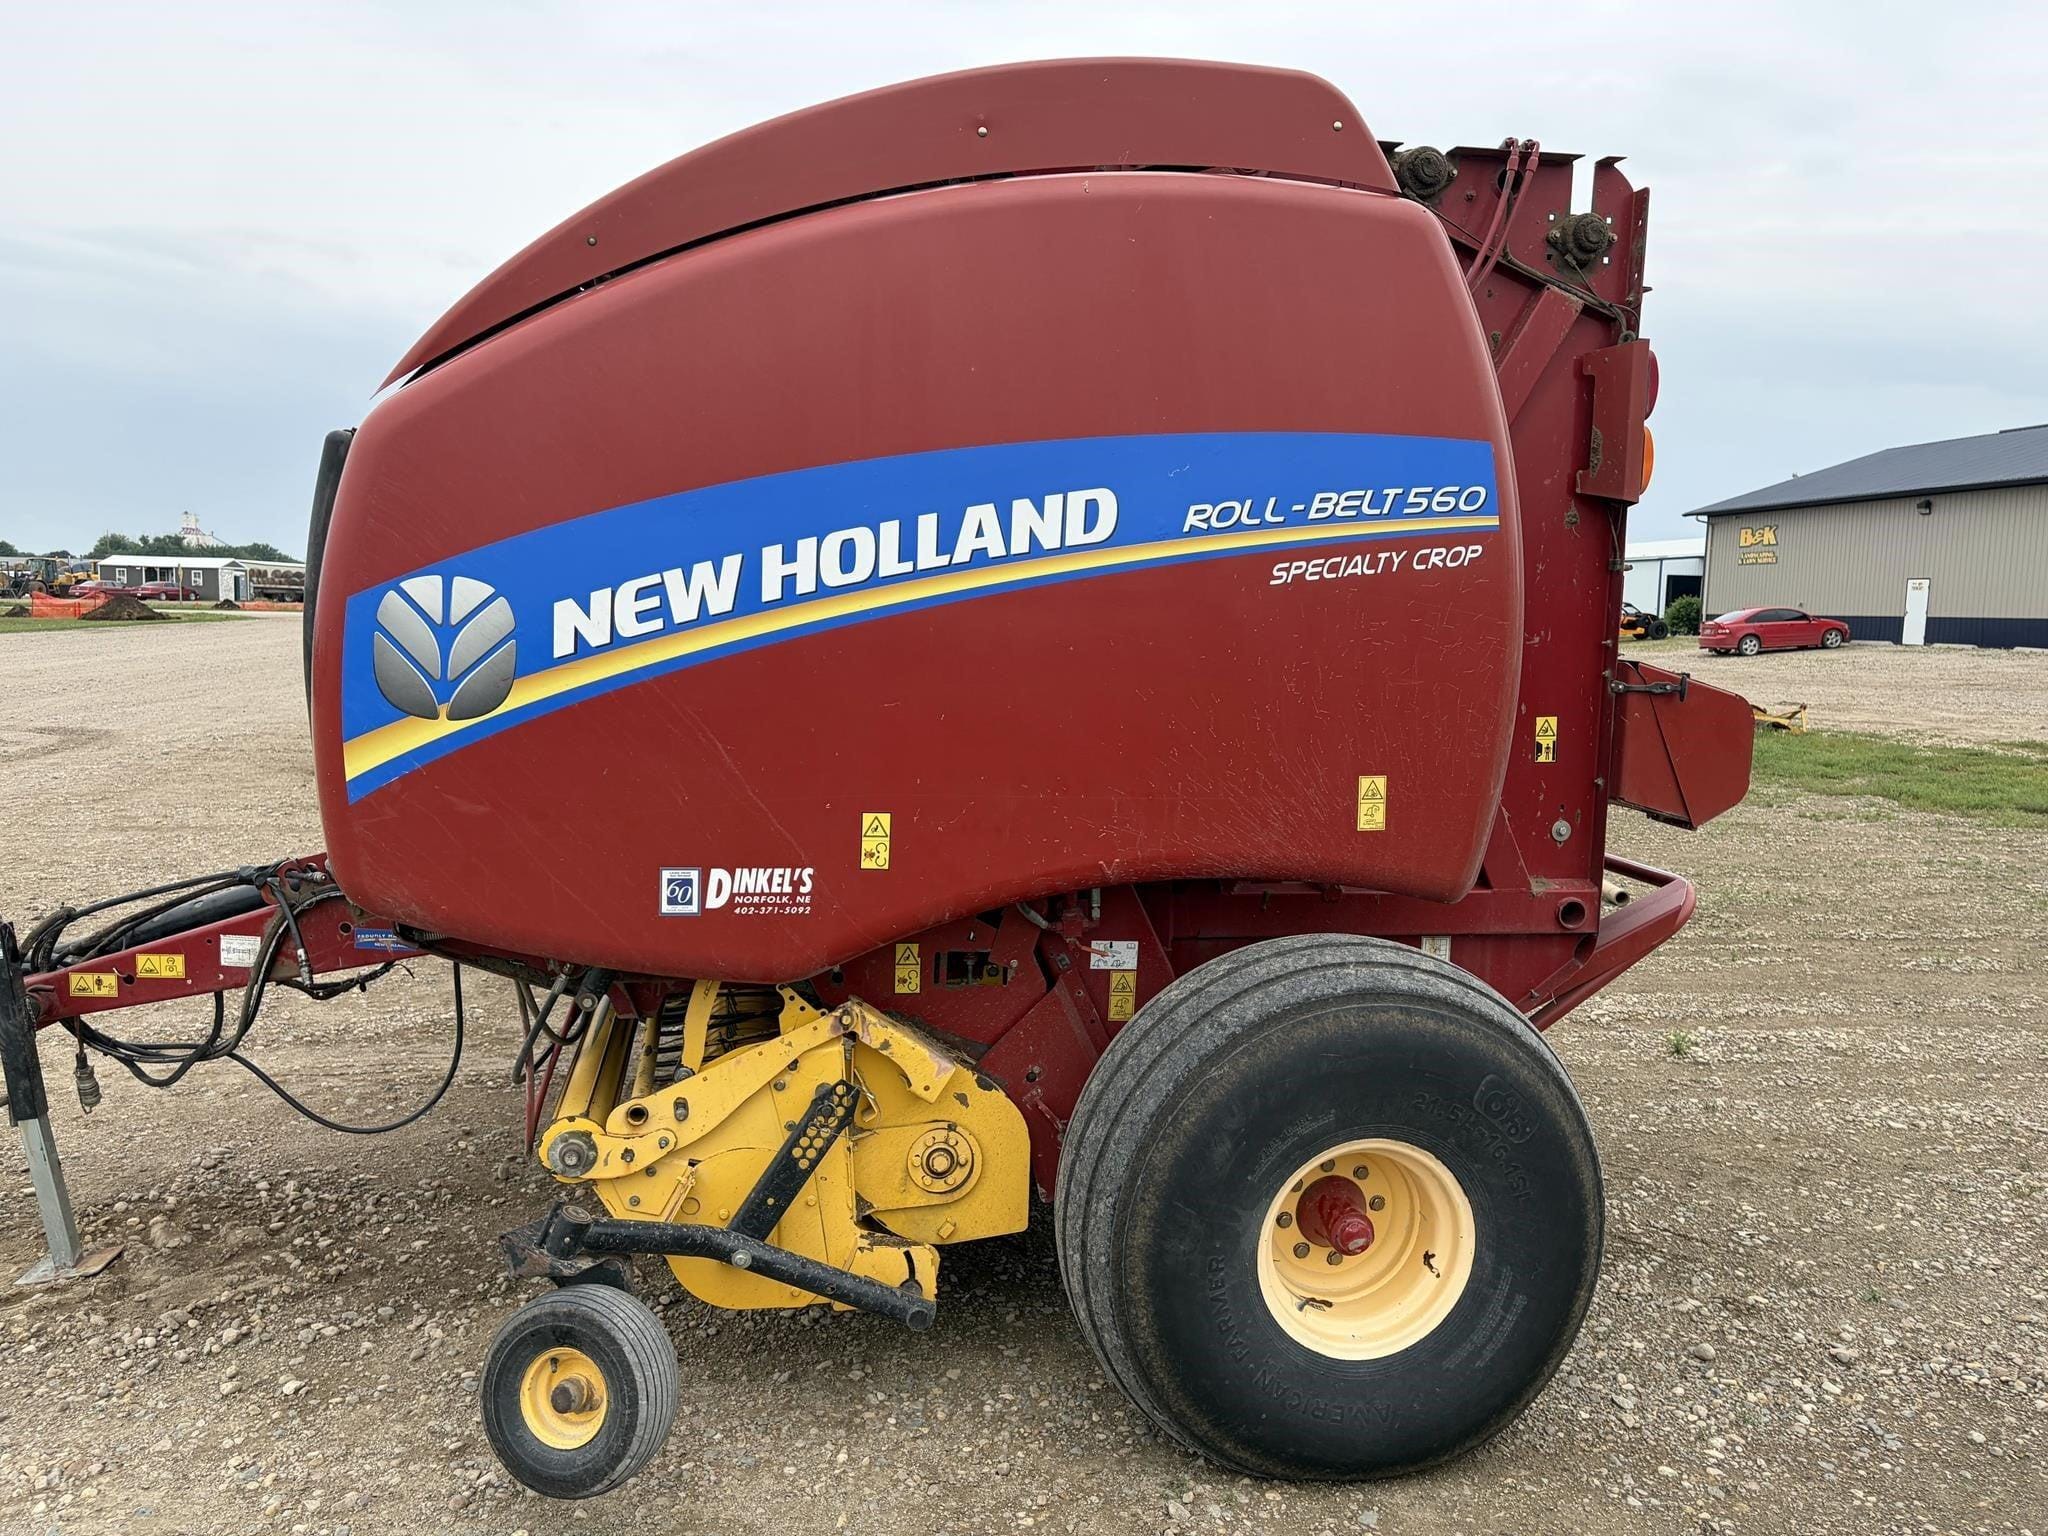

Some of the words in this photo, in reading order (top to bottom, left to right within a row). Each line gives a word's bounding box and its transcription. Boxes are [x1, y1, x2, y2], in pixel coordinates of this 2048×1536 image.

[1739, 526, 1777, 547] B&K
[553, 554, 743, 659] NEW
[761, 487, 1119, 602] HOLLAND
[1270, 550, 1407, 586] SPECIALTY
[1412, 545, 1483, 571] CROP
[667, 880, 692, 903] 60
[705, 868, 814, 909] DINKEL'S
[734, 896, 793, 905] NORFOLK,
[796, 895, 811, 904] NE
[734, 906, 811, 915] 402-371-5092
